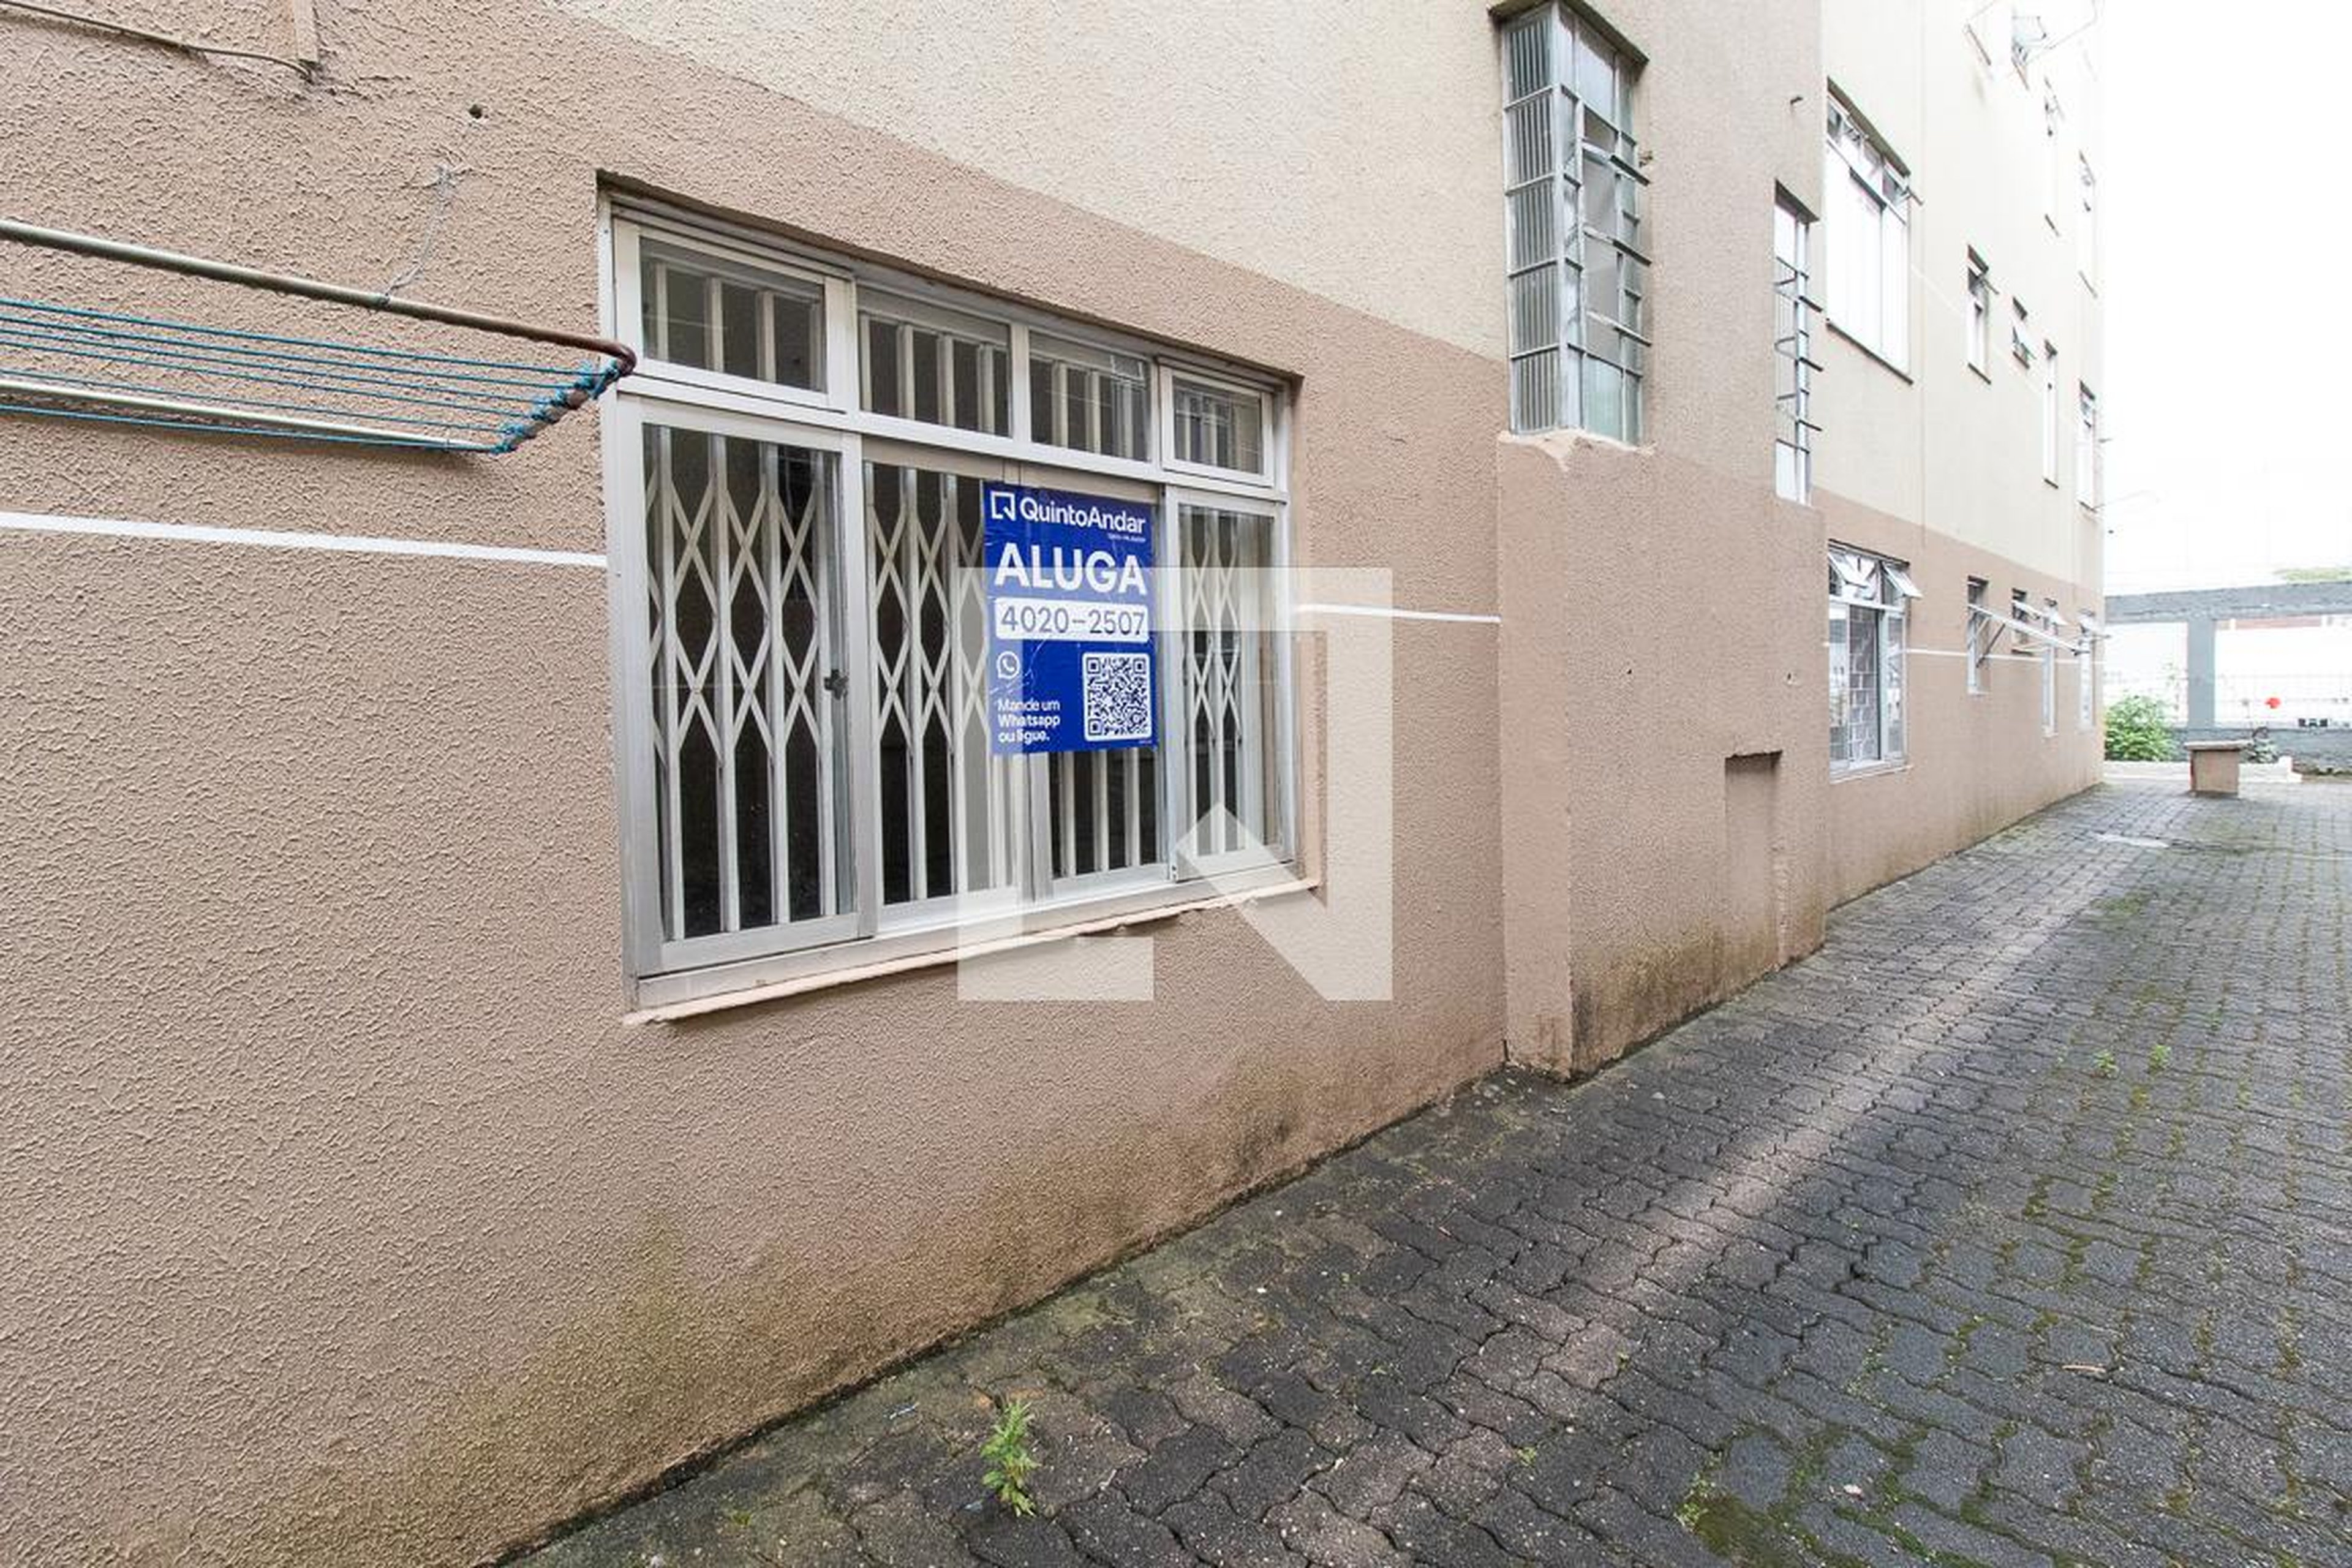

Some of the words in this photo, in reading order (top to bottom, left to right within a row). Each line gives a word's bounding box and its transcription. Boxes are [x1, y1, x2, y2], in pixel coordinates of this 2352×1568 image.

[1020, 497, 1146, 534] QuintoAndar
[994, 542, 1147, 596] ALUGA
[1001, 605, 1145, 635] 4020-2507
[997, 698, 1040, 711] Mande
[1041, 700, 1061, 711] um
[997, 714, 1061, 729] Whatsapp
[998, 732, 1016, 744] ou
[1016, 729, 1050, 745] ligue.
